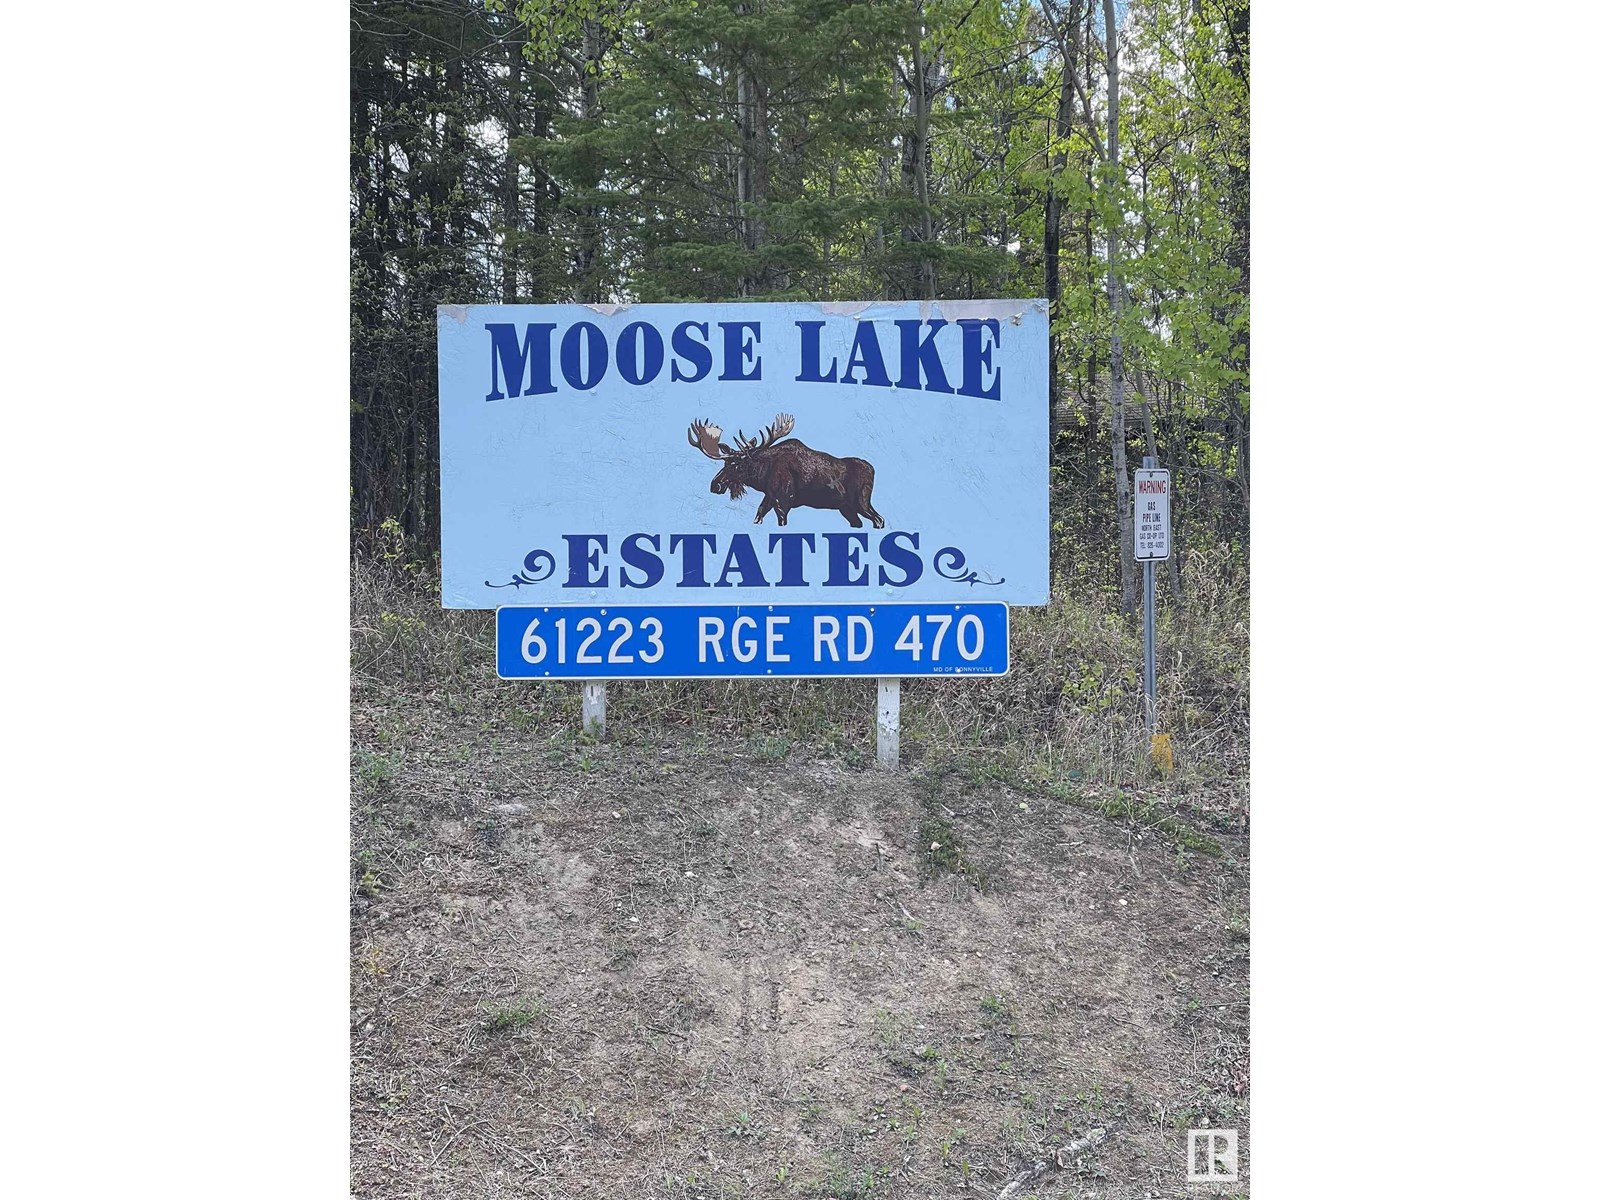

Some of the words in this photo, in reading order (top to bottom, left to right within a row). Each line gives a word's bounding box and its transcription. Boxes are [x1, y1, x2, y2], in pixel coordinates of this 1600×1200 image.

[485, 320, 762, 402] MOOSE
[795, 318, 1001, 401] LAKE
[1139, 480, 1166, 494] WARNING
[1142, 513, 1151, 523] PIPE
[1152, 512, 1161, 522] LINE
[1147, 501, 1156, 511] GAS
[561, 530, 924, 589] ESTATES
[520, 617, 665, 665] 61223
[698, 616, 791, 663] RGE
[813, 615, 875, 662] RD
[894, 614, 985, 661] 470
